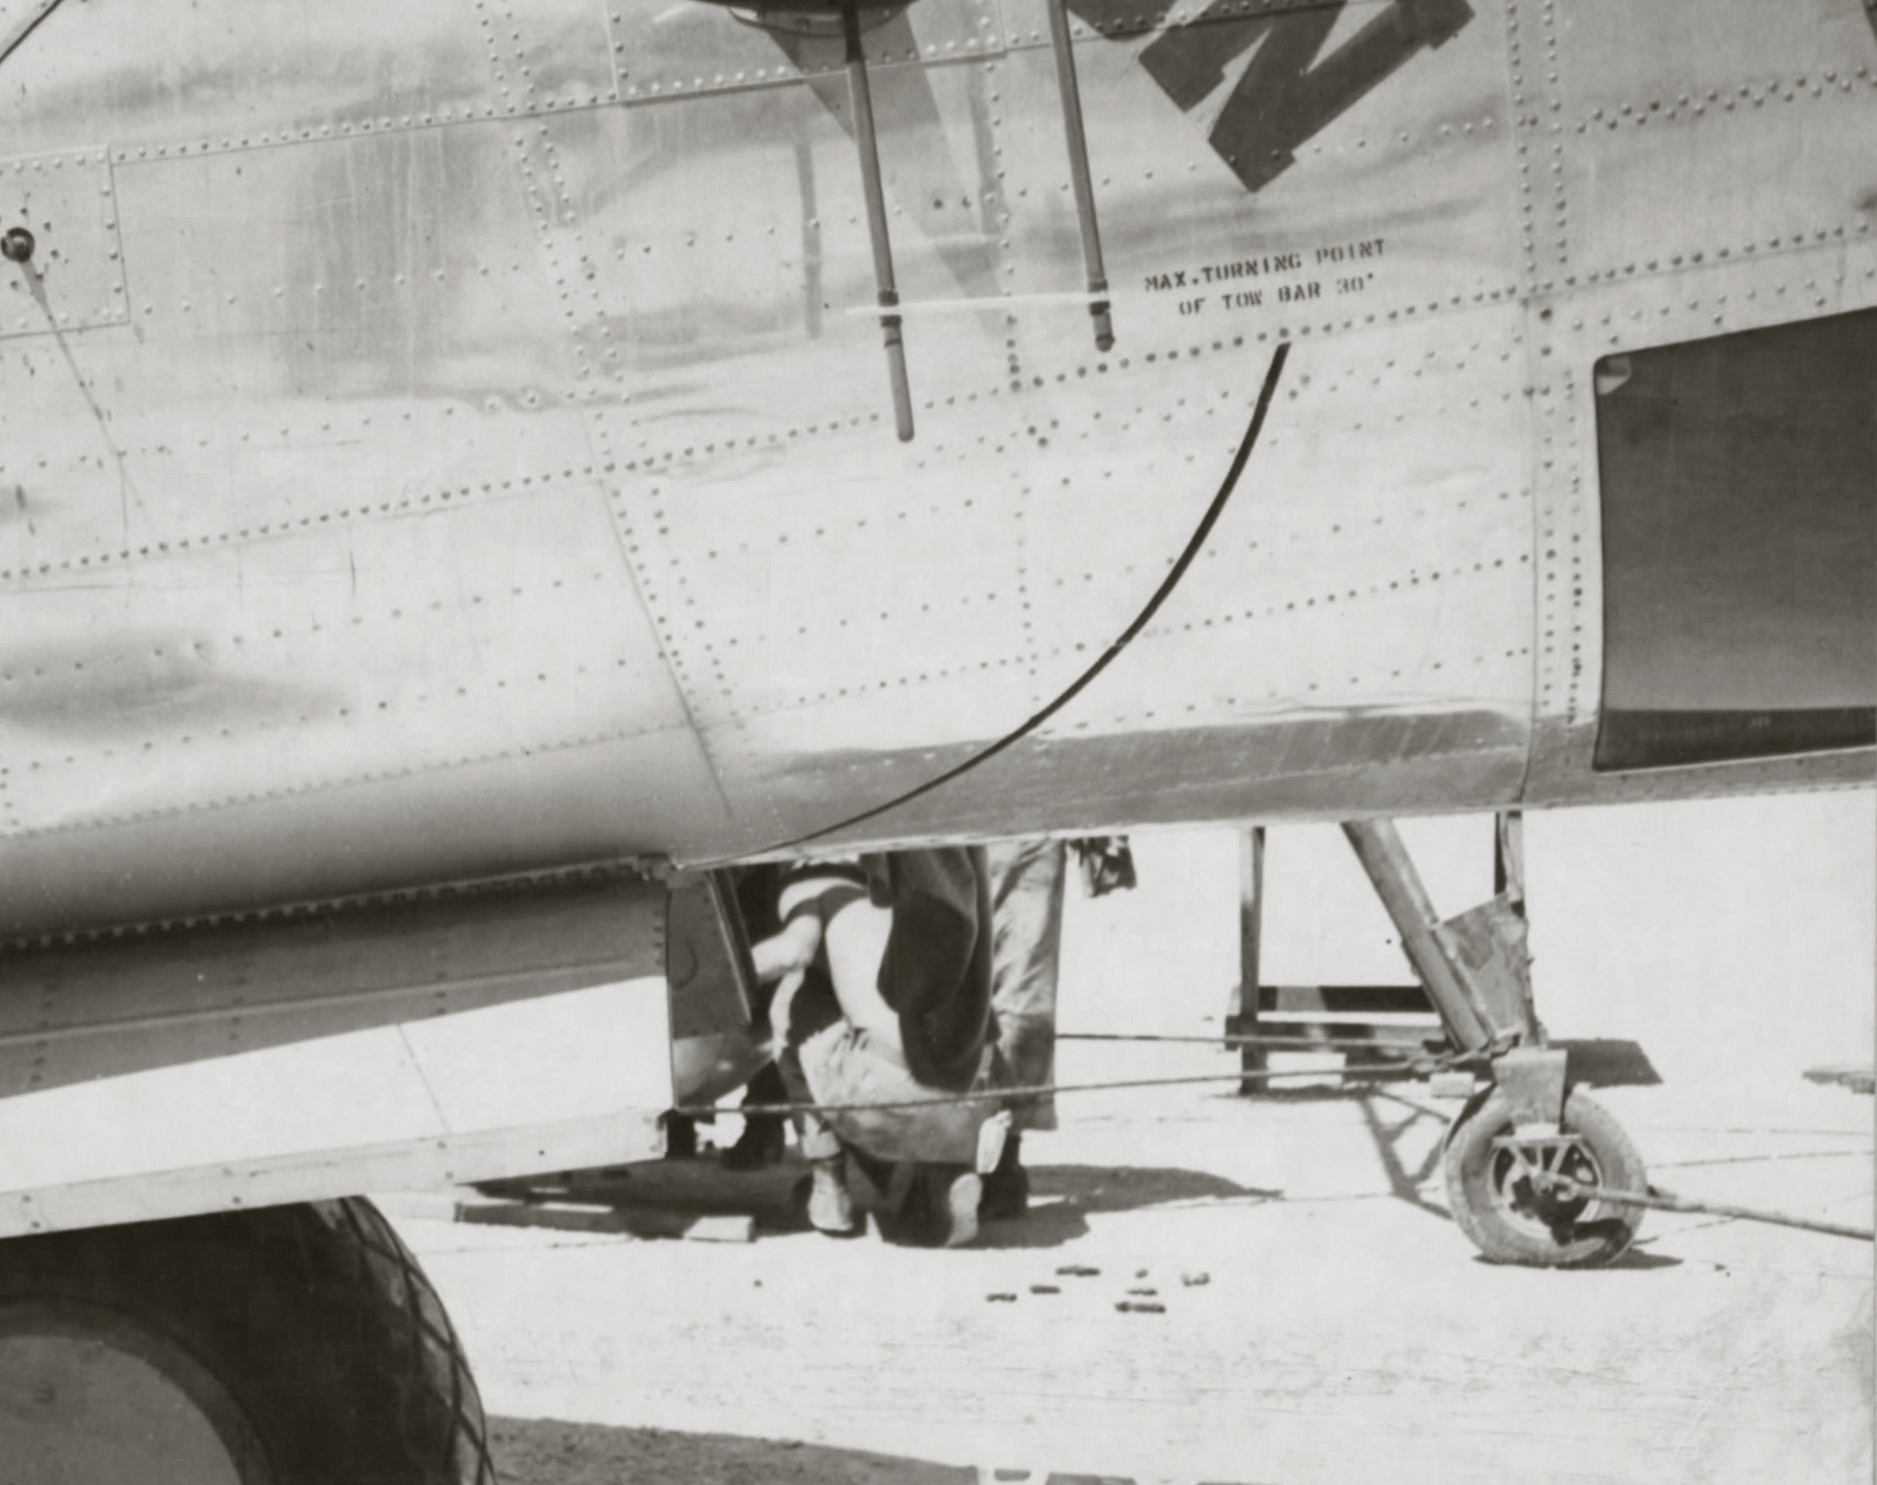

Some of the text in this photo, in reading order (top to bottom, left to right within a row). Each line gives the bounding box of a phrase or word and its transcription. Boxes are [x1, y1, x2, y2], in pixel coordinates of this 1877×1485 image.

[1315, 238, 1386, 265] POINT
[1178, 296, 1206, 316] OF
[1221, 289, 1263, 311] TOW
[1277, 280, 1322, 304] BAR
